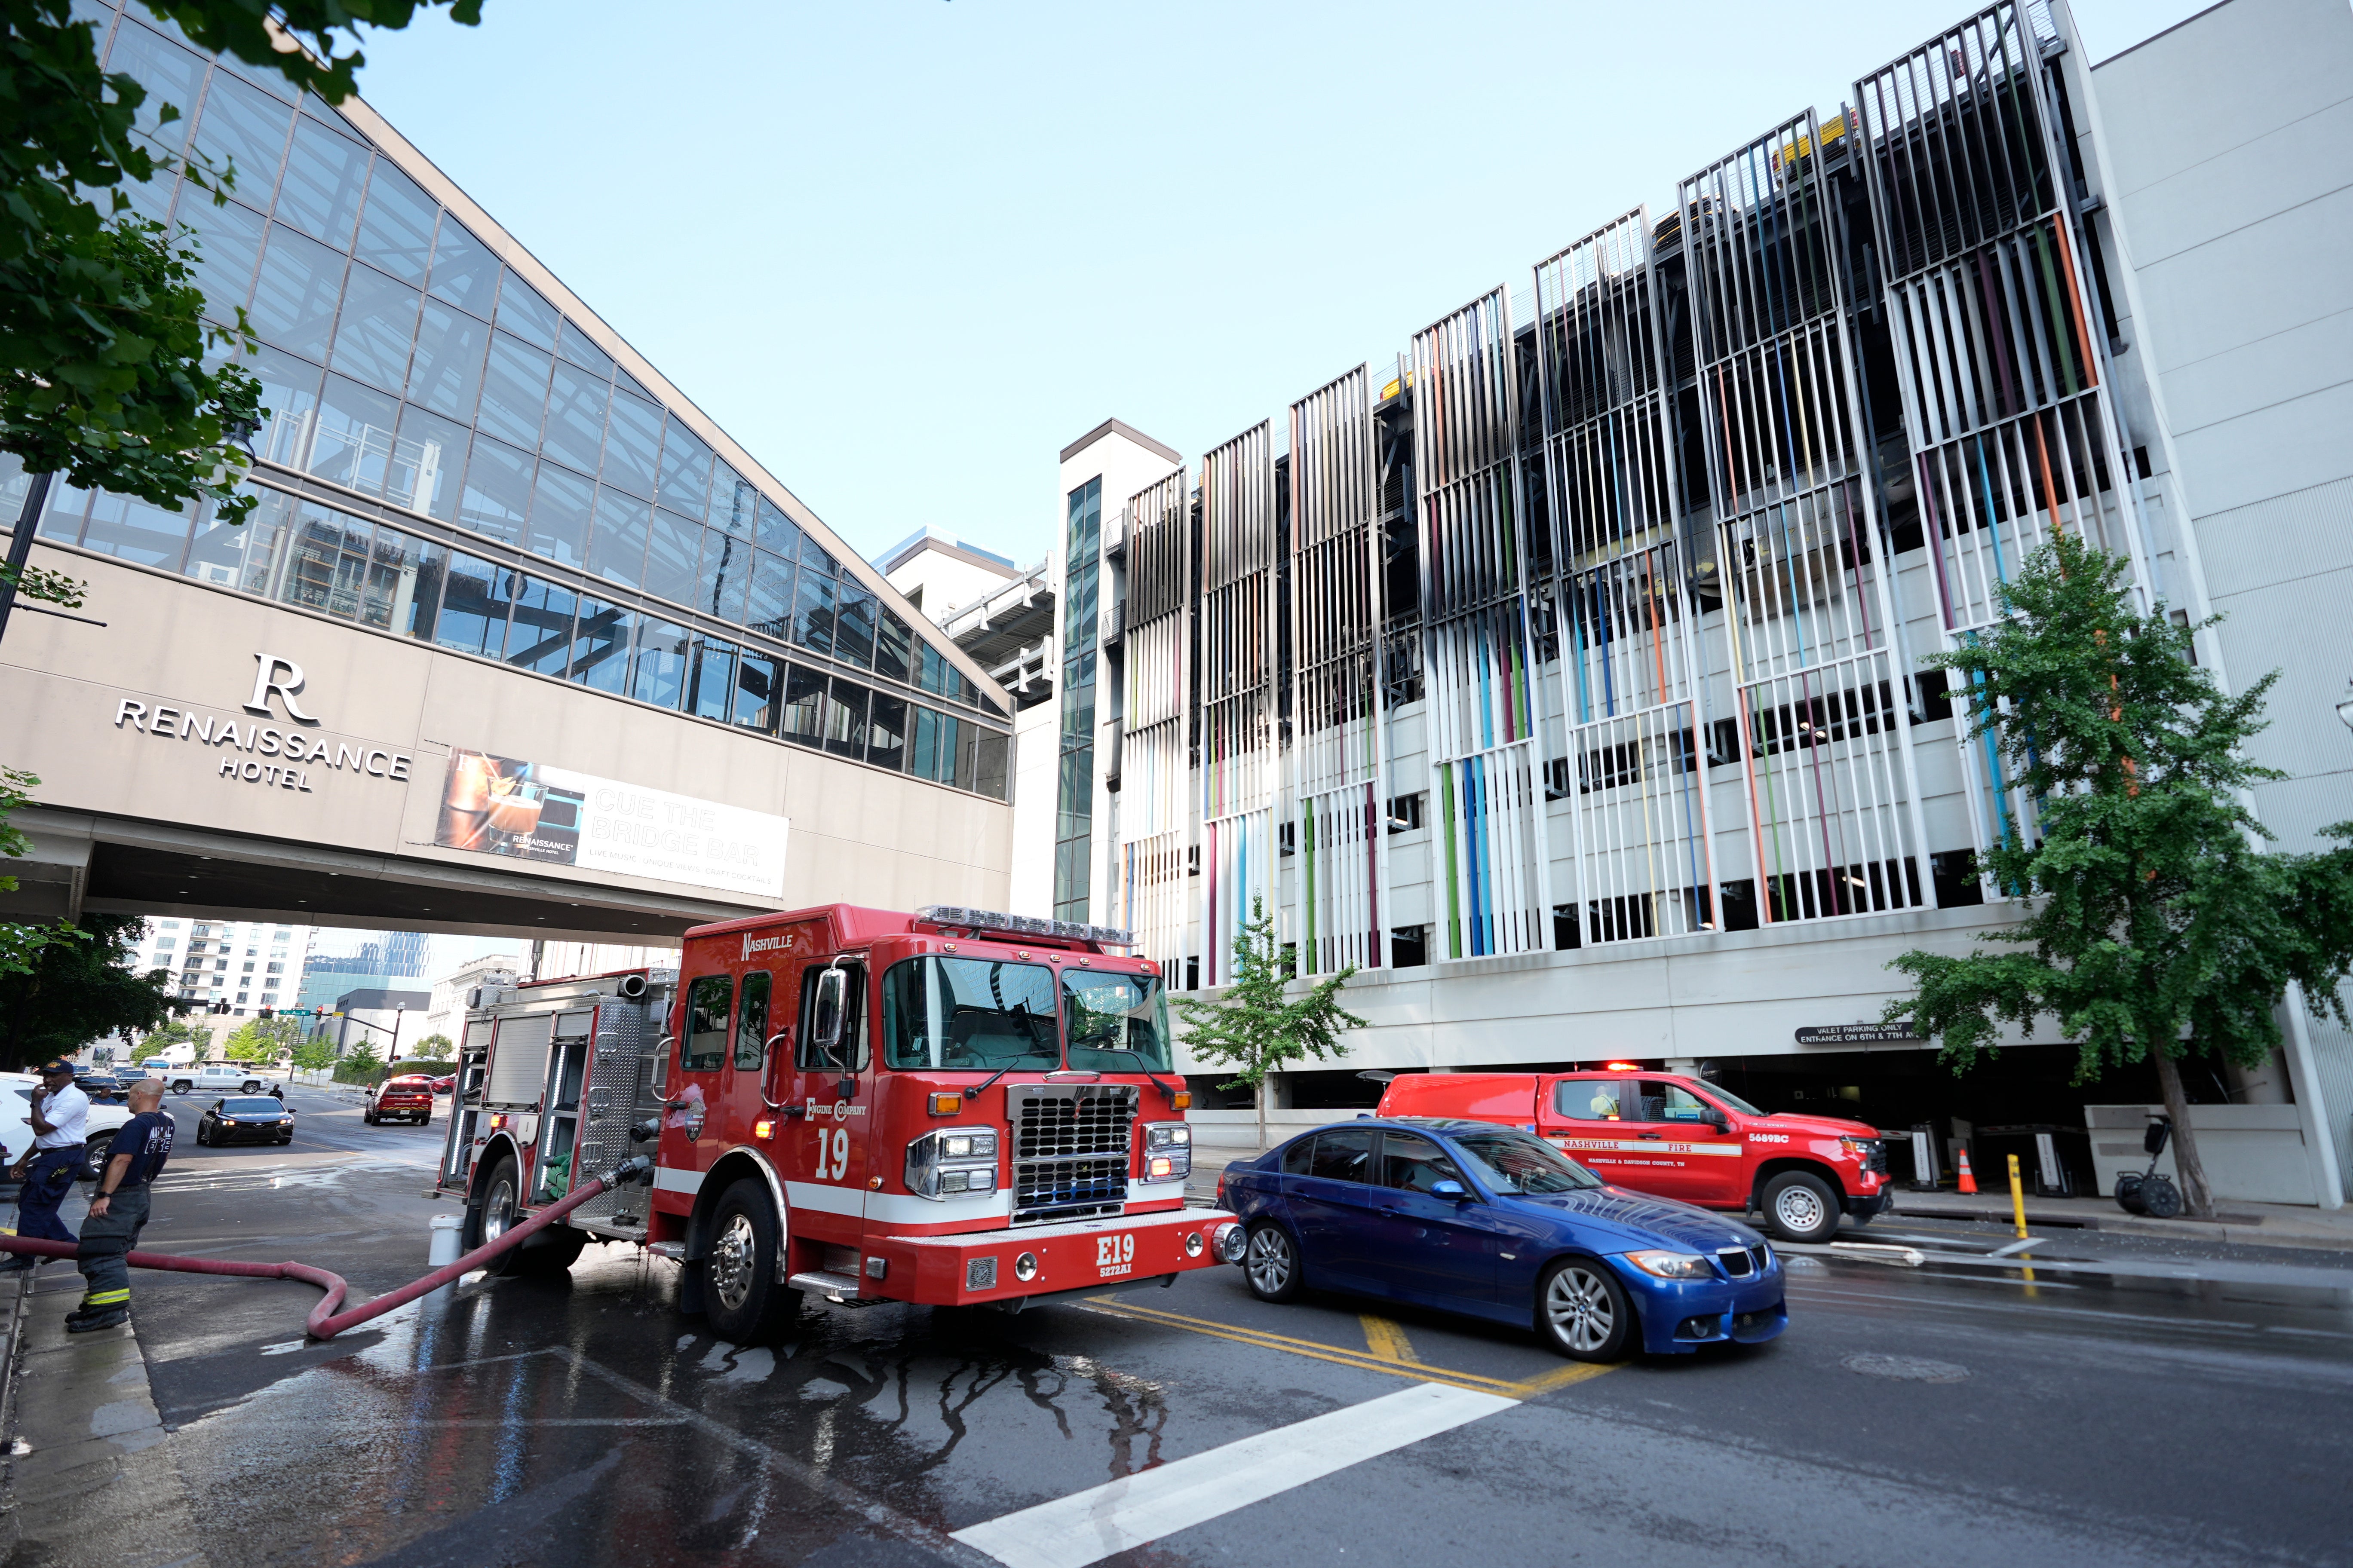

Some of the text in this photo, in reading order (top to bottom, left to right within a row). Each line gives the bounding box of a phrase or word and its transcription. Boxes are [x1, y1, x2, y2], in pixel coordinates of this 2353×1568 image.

[242, 652, 319, 720] R
[115, 698, 411, 779] RENAISSANCE
[219, 756, 311, 790] HOTEL
[595, 788, 715, 831] CUE THE
[592, 816, 759, 866] BRIDGE BAR
[589, 849, 771, 884] LIVE MUSIC UNIQUE VIEWS CRAFT COCKTAILS
[741, 932, 793, 962] NASHVILLE
[1843, 1025, 1878, 1033] PARKING
[805, 1097, 867, 1122] ENGINE COMPANY
[816, 1127, 849, 1181] 19
[1564, 1140, 1692, 1152] NASHVILLE FIRE
[1749, 1133, 1789, 1143] 5689BC
[1096, 1233, 1135, 1266] E19
[1099, 1263, 1132, 1277] 5272AI
